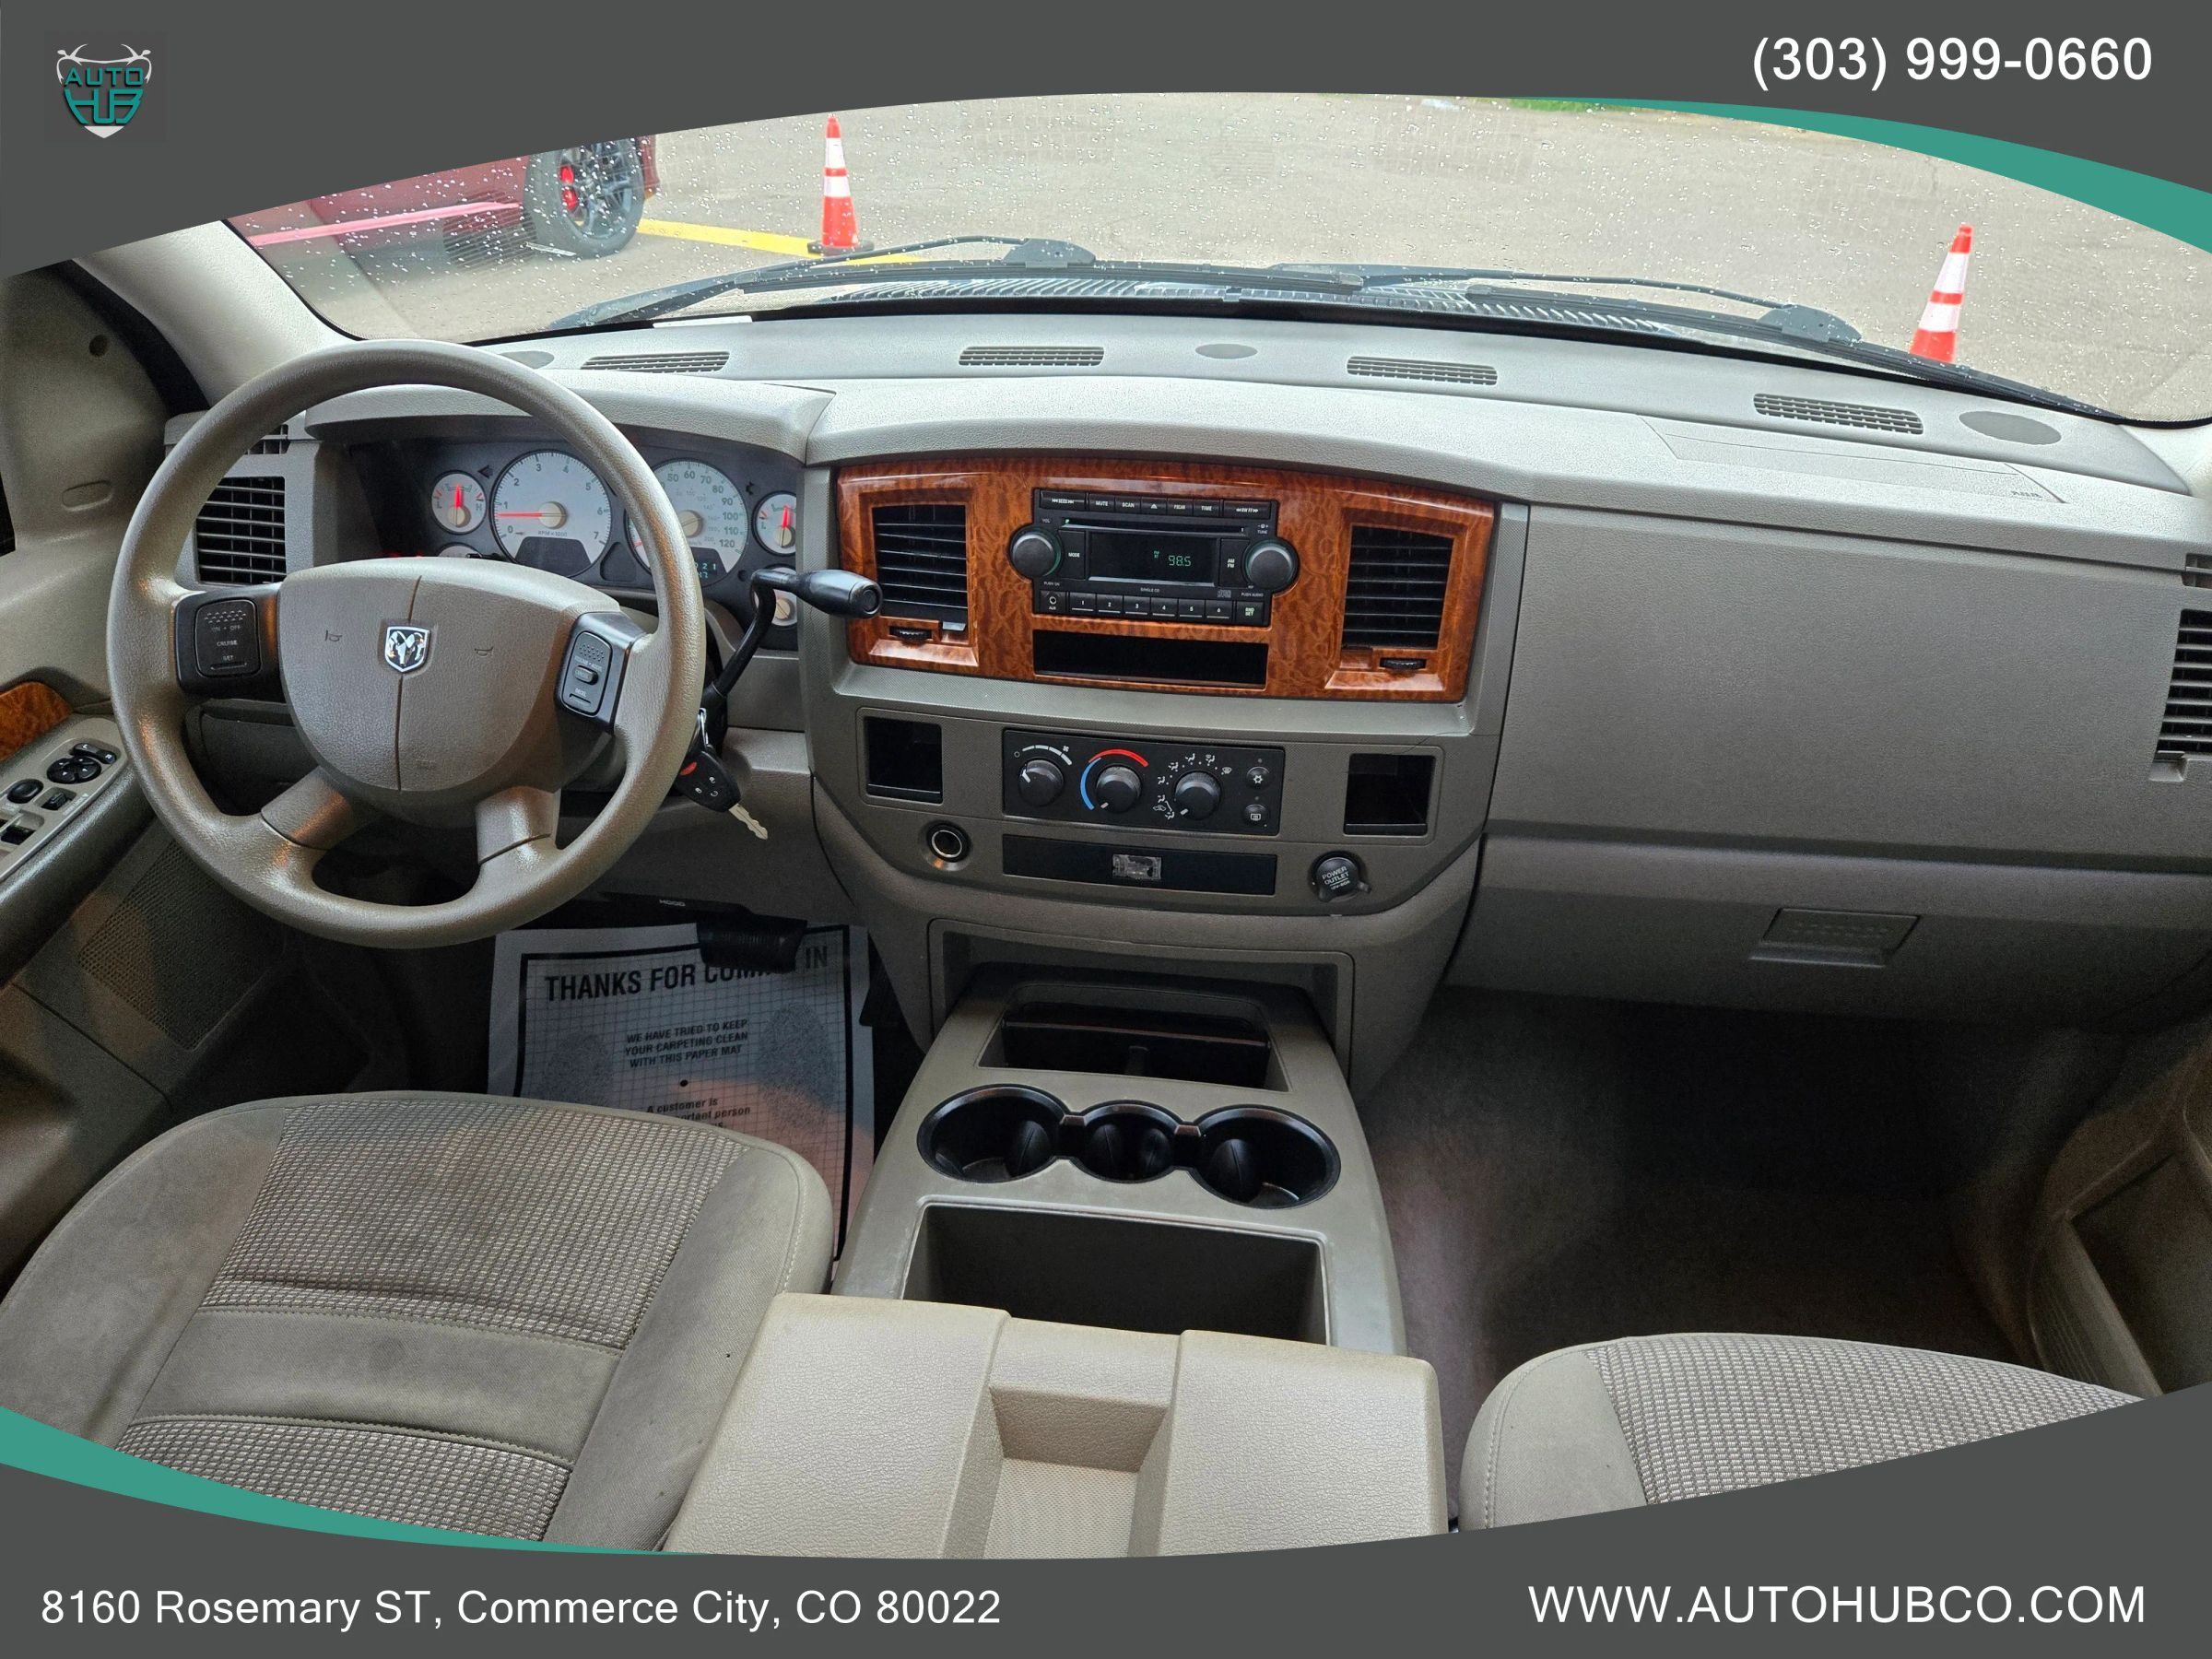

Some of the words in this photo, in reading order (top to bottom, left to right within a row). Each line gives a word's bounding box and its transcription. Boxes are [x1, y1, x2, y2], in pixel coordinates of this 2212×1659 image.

[562, 465, 569, 474] 4
[667, 473, 679, 482] 50
[684, 471, 695, 479] 60
[513, 478, 519, 487] 2
[700, 476, 712, 484] 70
[585, 483, 591, 491] 5
[712, 485, 724, 494] 80
[722, 497, 733, 506] 90
[597, 507, 603, 515] 6
[723, 512, 738, 520] 100
[507, 525, 513, 534] 0
[724, 526, 737, 535] 110
[594, 532, 599, 540] 7
[720, 539, 735, 548] 120
[1322, 865, 1347, 880] POWER
[1324, 871, 1349, 885] OUTLET
[545, 970, 641, 1001] THANKS
[650, 963, 696, 992] FOR
[806, 946, 828, 969] IN
[627, 1033, 642, 1043] WE
[645, 1029, 671, 1041] HAVE
[674, 1025, 703, 1037] TRIED
[707, 1022, 720, 1031] TO
[723, 1018, 748, 1030] KEEP
[625, 1044, 653, 1056] YOUR
[656, 1036, 713, 1053] CARPETING
[716, 1032, 748, 1044] CLEAN
[629, 1056, 656, 1068] WITH
[659, 1053, 682, 1065] THIS
[685, 1047, 718, 1060] PAPER
[721, 1044, 744, 1055] MAT
[647, 1105, 654, 1113] A
[657, 1100, 706, 1112] customer
[714, 1107, 751, 1119] person
